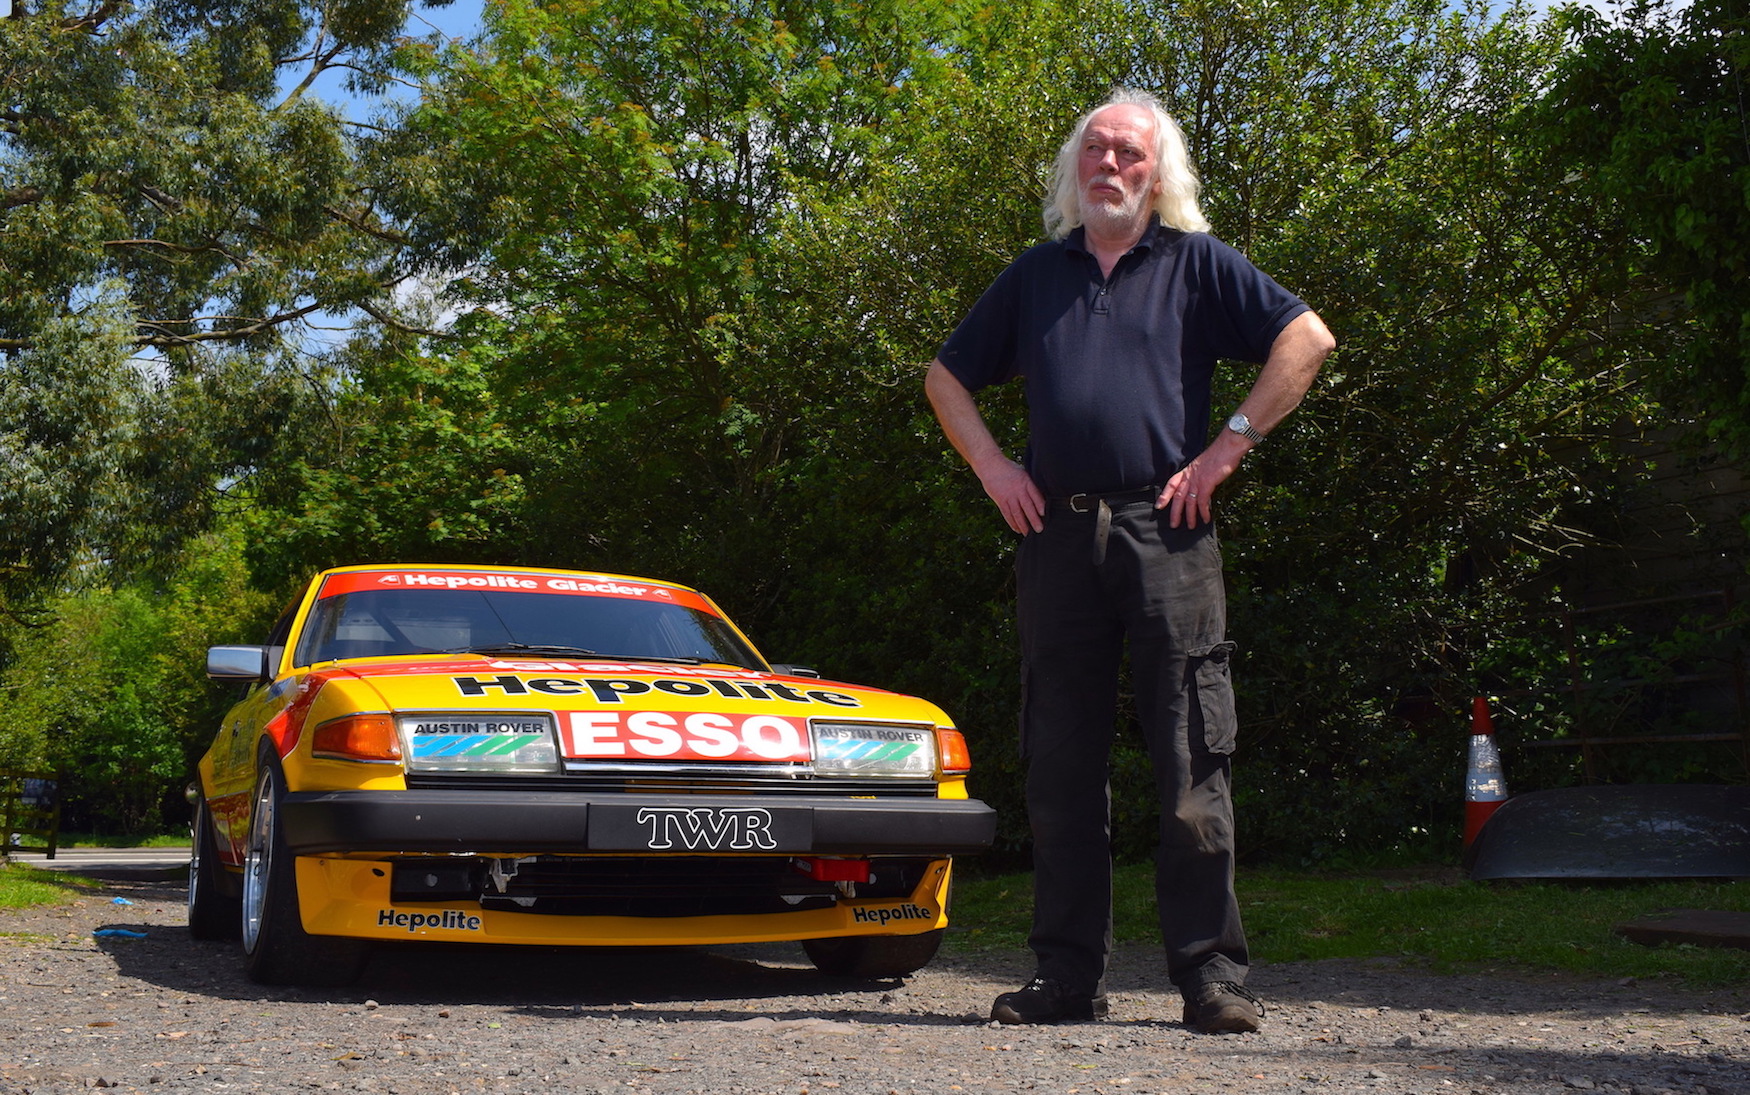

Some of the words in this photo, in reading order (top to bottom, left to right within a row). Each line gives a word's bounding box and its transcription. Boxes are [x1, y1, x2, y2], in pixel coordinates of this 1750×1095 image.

[405, 574, 538, 589] Hepolite
[546, 578, 648, 597] Glacier
[450, 674, 865, 708] Hepolite
[414, 723, 479, 734] AUSTIN
[486, 723, 544, 733] ROVER
[569, 711, 801, 759] ESSO
[820, 728, 873, 739] AUSTIN
[879, 730, 923, 742] ROVER
[637, 807, 777, 850] TWR
[377, 909, 481, 933] Hepolite
[852, 904, 932, 926] Hepolite
